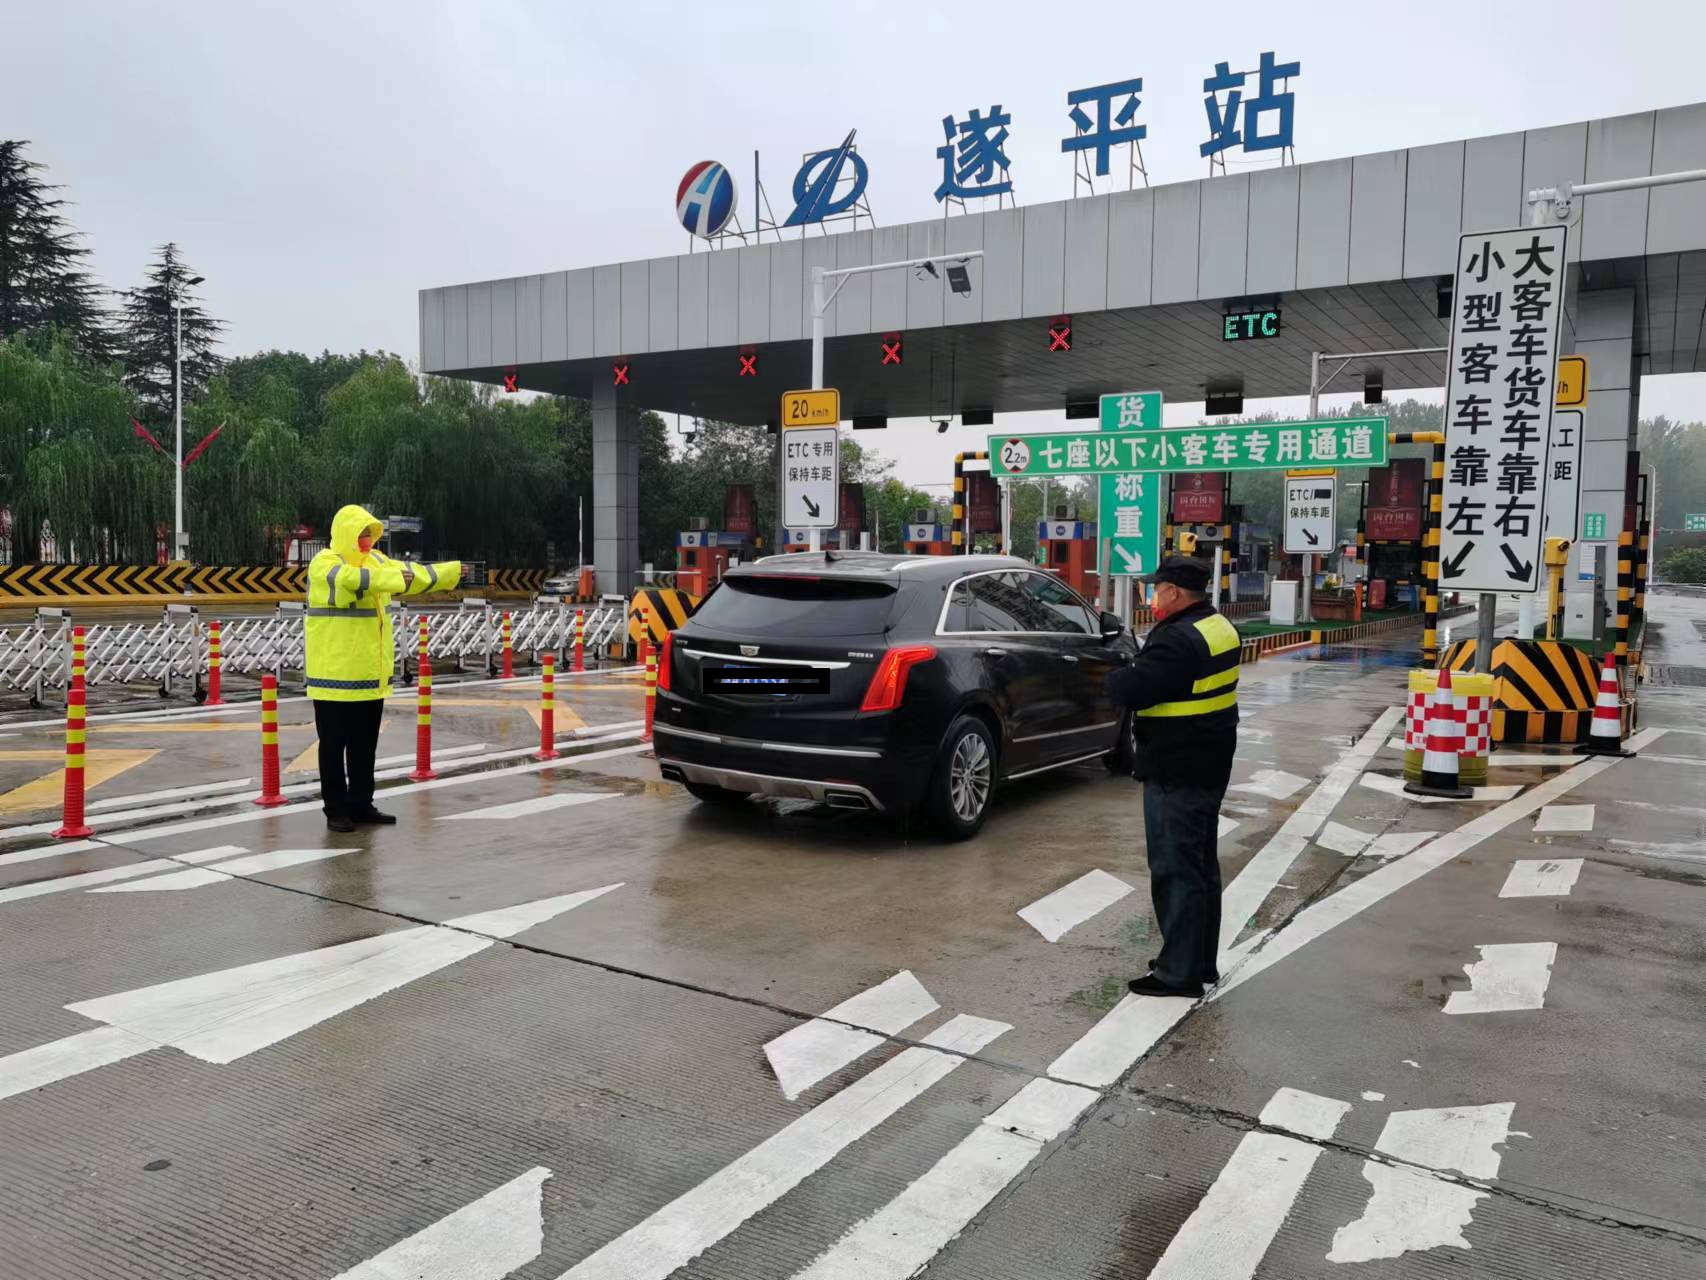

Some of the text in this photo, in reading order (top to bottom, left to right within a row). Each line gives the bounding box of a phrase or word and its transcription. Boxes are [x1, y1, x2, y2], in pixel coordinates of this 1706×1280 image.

[934, 51, 1301, 203] 遂平站
[1225, 312, 1277, 339] ETC
[1446, 242, 1505, 535] 小型客车靠左
[1493, 236, 1555, 536] 大客车货车靠右
[792, 400, 808, 418] 20
[1039, 425, 1374, 469] 七座以下小客车专用通道
[1114, 396, 1145, 538] 货称重
[788, 466, 832, 482] 保持车距
[1290, 506, 1330, 519] 保持车距
